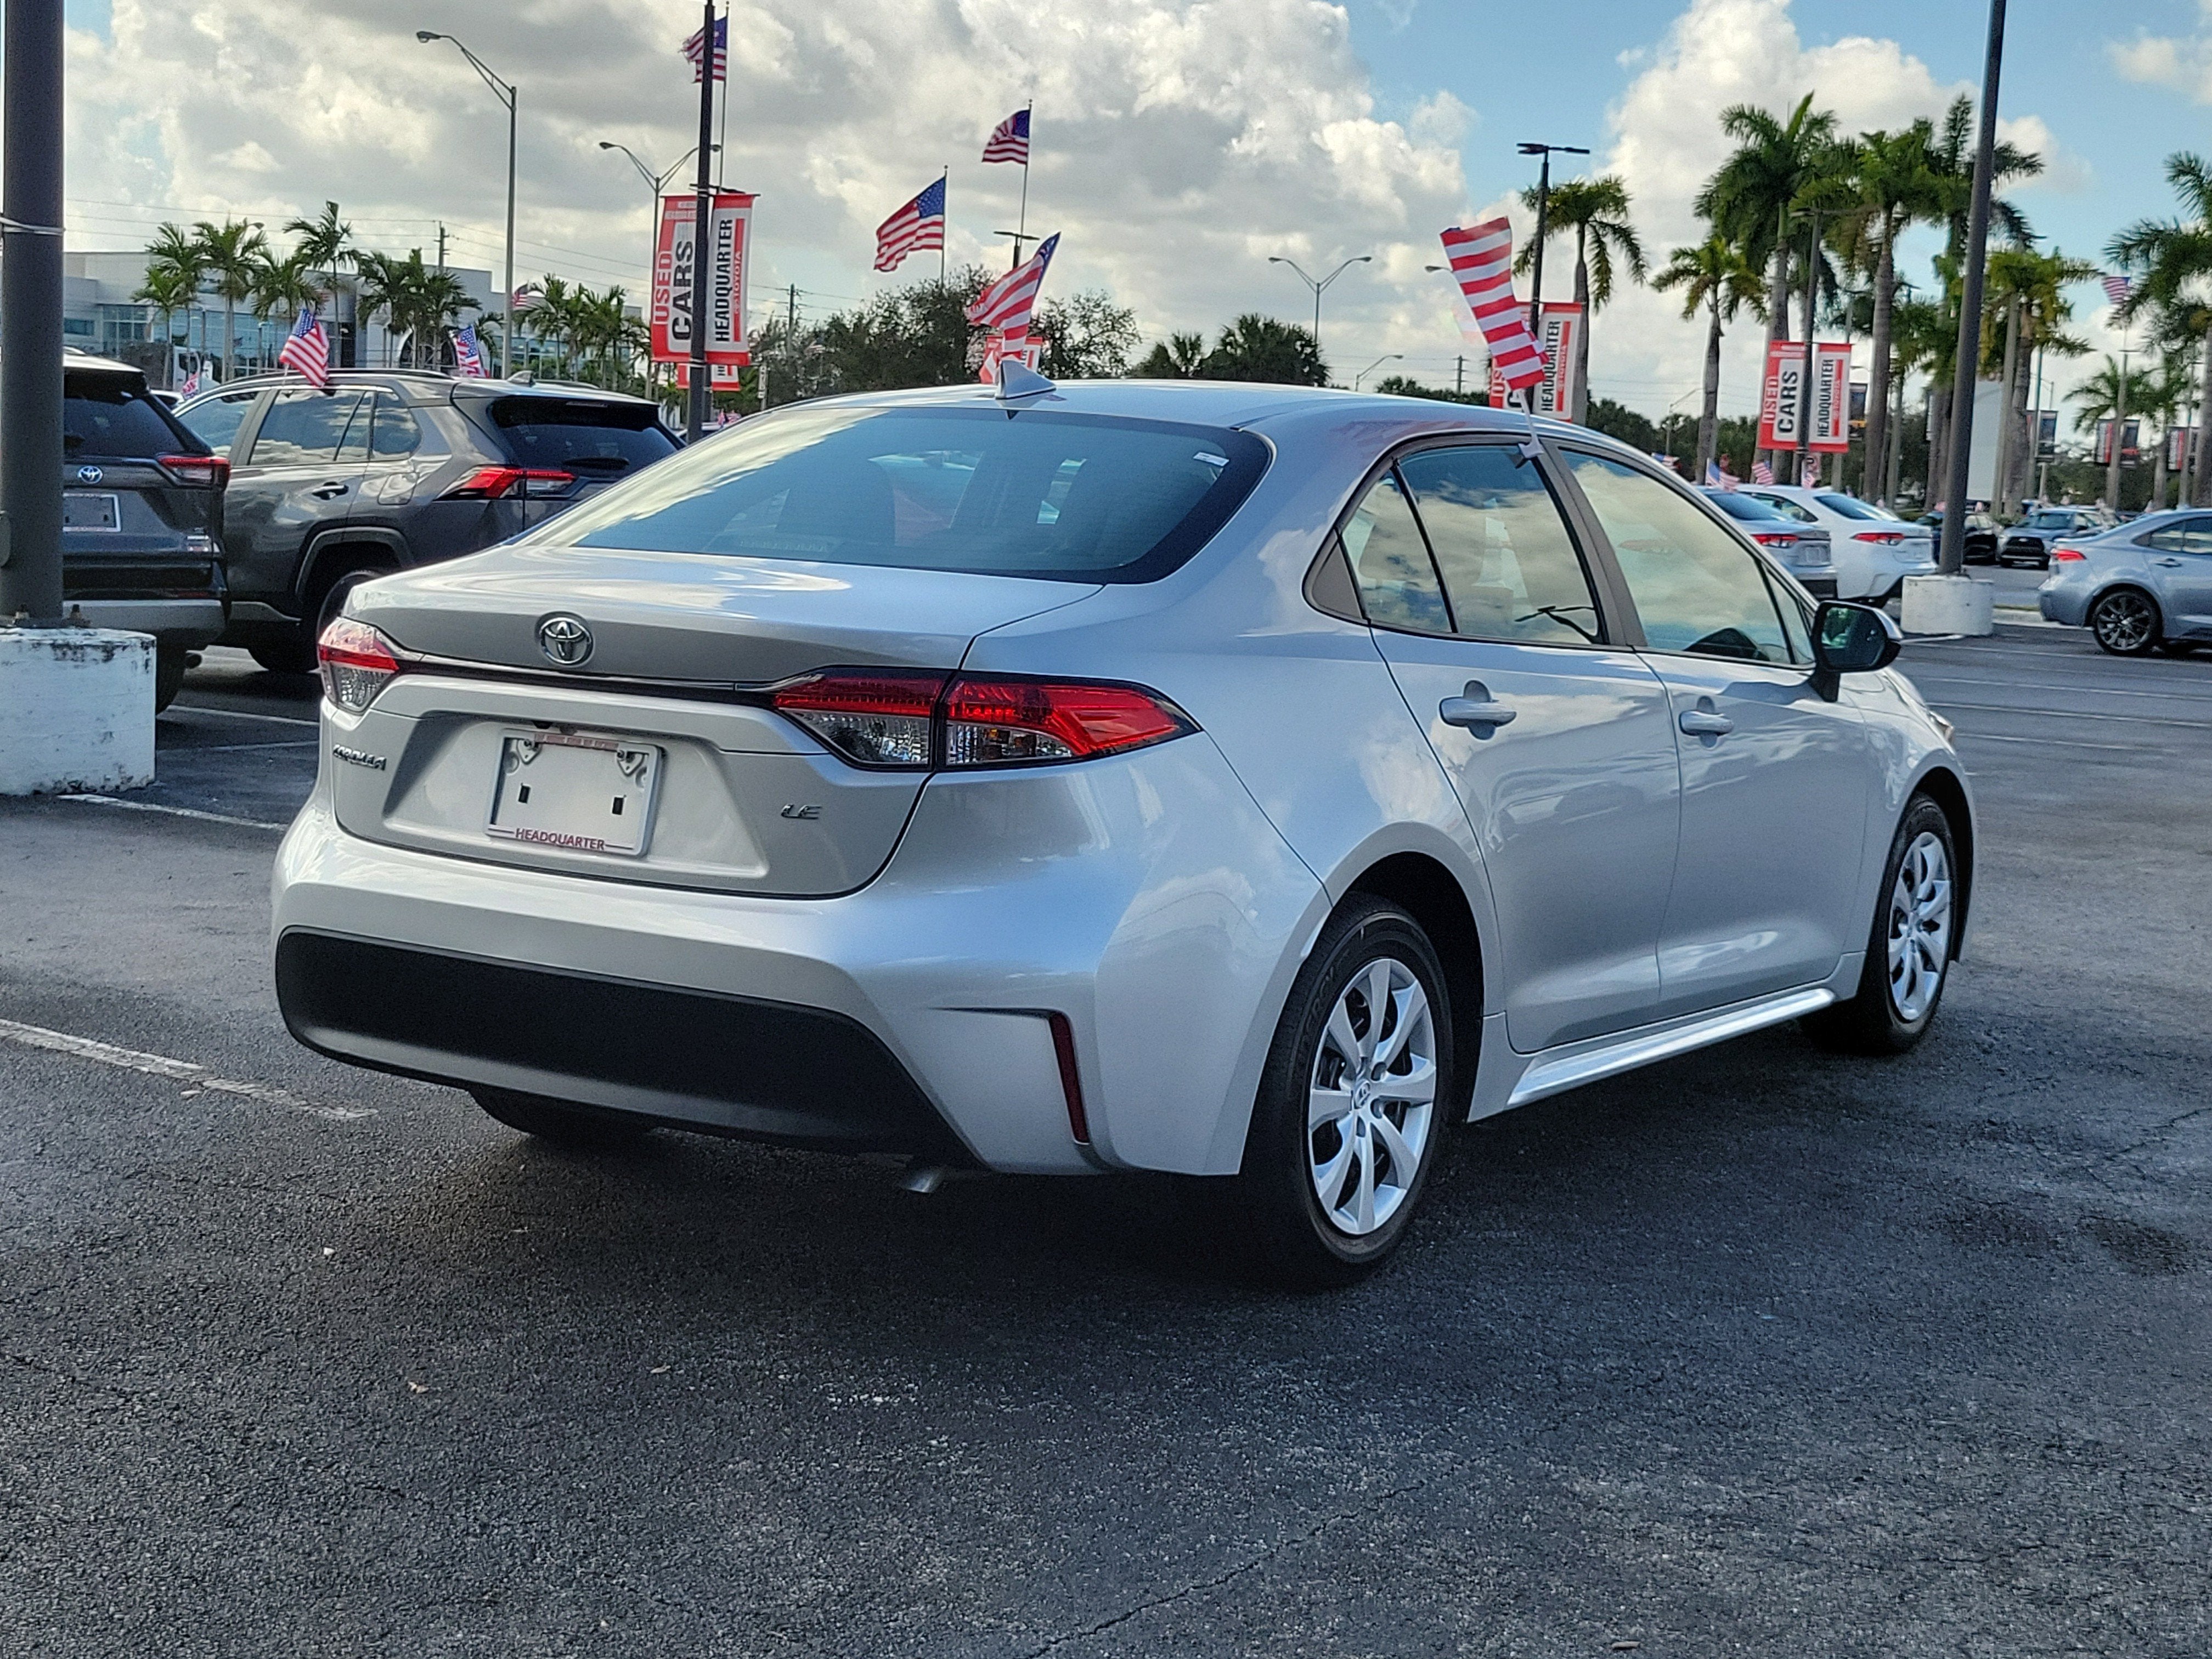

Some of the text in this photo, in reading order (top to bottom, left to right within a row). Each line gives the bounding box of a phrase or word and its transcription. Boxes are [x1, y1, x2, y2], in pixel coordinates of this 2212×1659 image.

[653, 252, 673, 324] USED
[672, 240, 693, 340] CARS
[715, 219, 733, 342] HEADQUARTER
[1762, 375, 1779, 423] USED
[1778, 370, 1798, 433] CARS
[1818, 359, 1834, 437] HEADQUARTER
[515, 827, 605, 850] HEADQUARTER
[780, 803, 822, 820] LE
